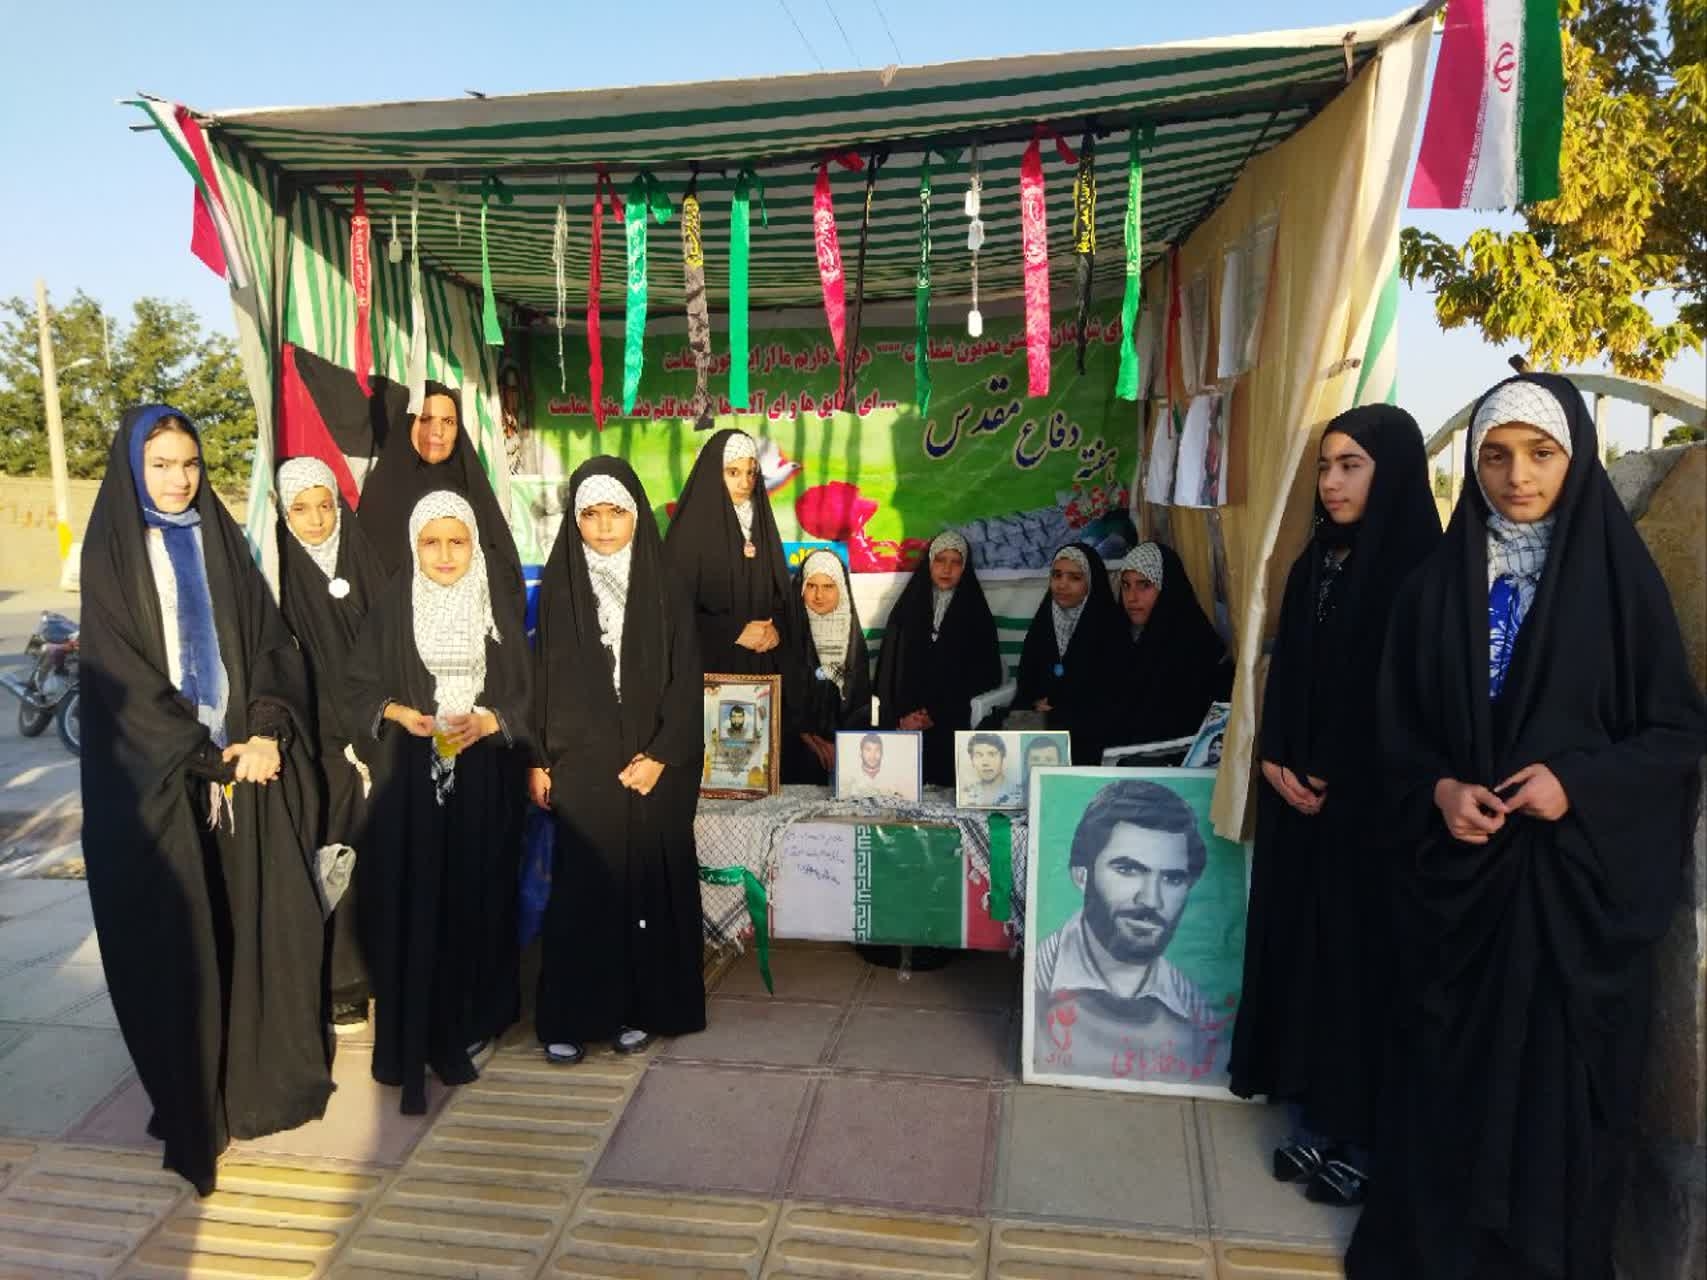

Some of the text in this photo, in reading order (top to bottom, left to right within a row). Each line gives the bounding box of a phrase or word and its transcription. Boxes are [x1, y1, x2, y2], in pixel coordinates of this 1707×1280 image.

[904, 338, 953, 361] شمات
[925, 376, 1021, 459] مقدس
[1015, 411, 1081, 469] دفاع
